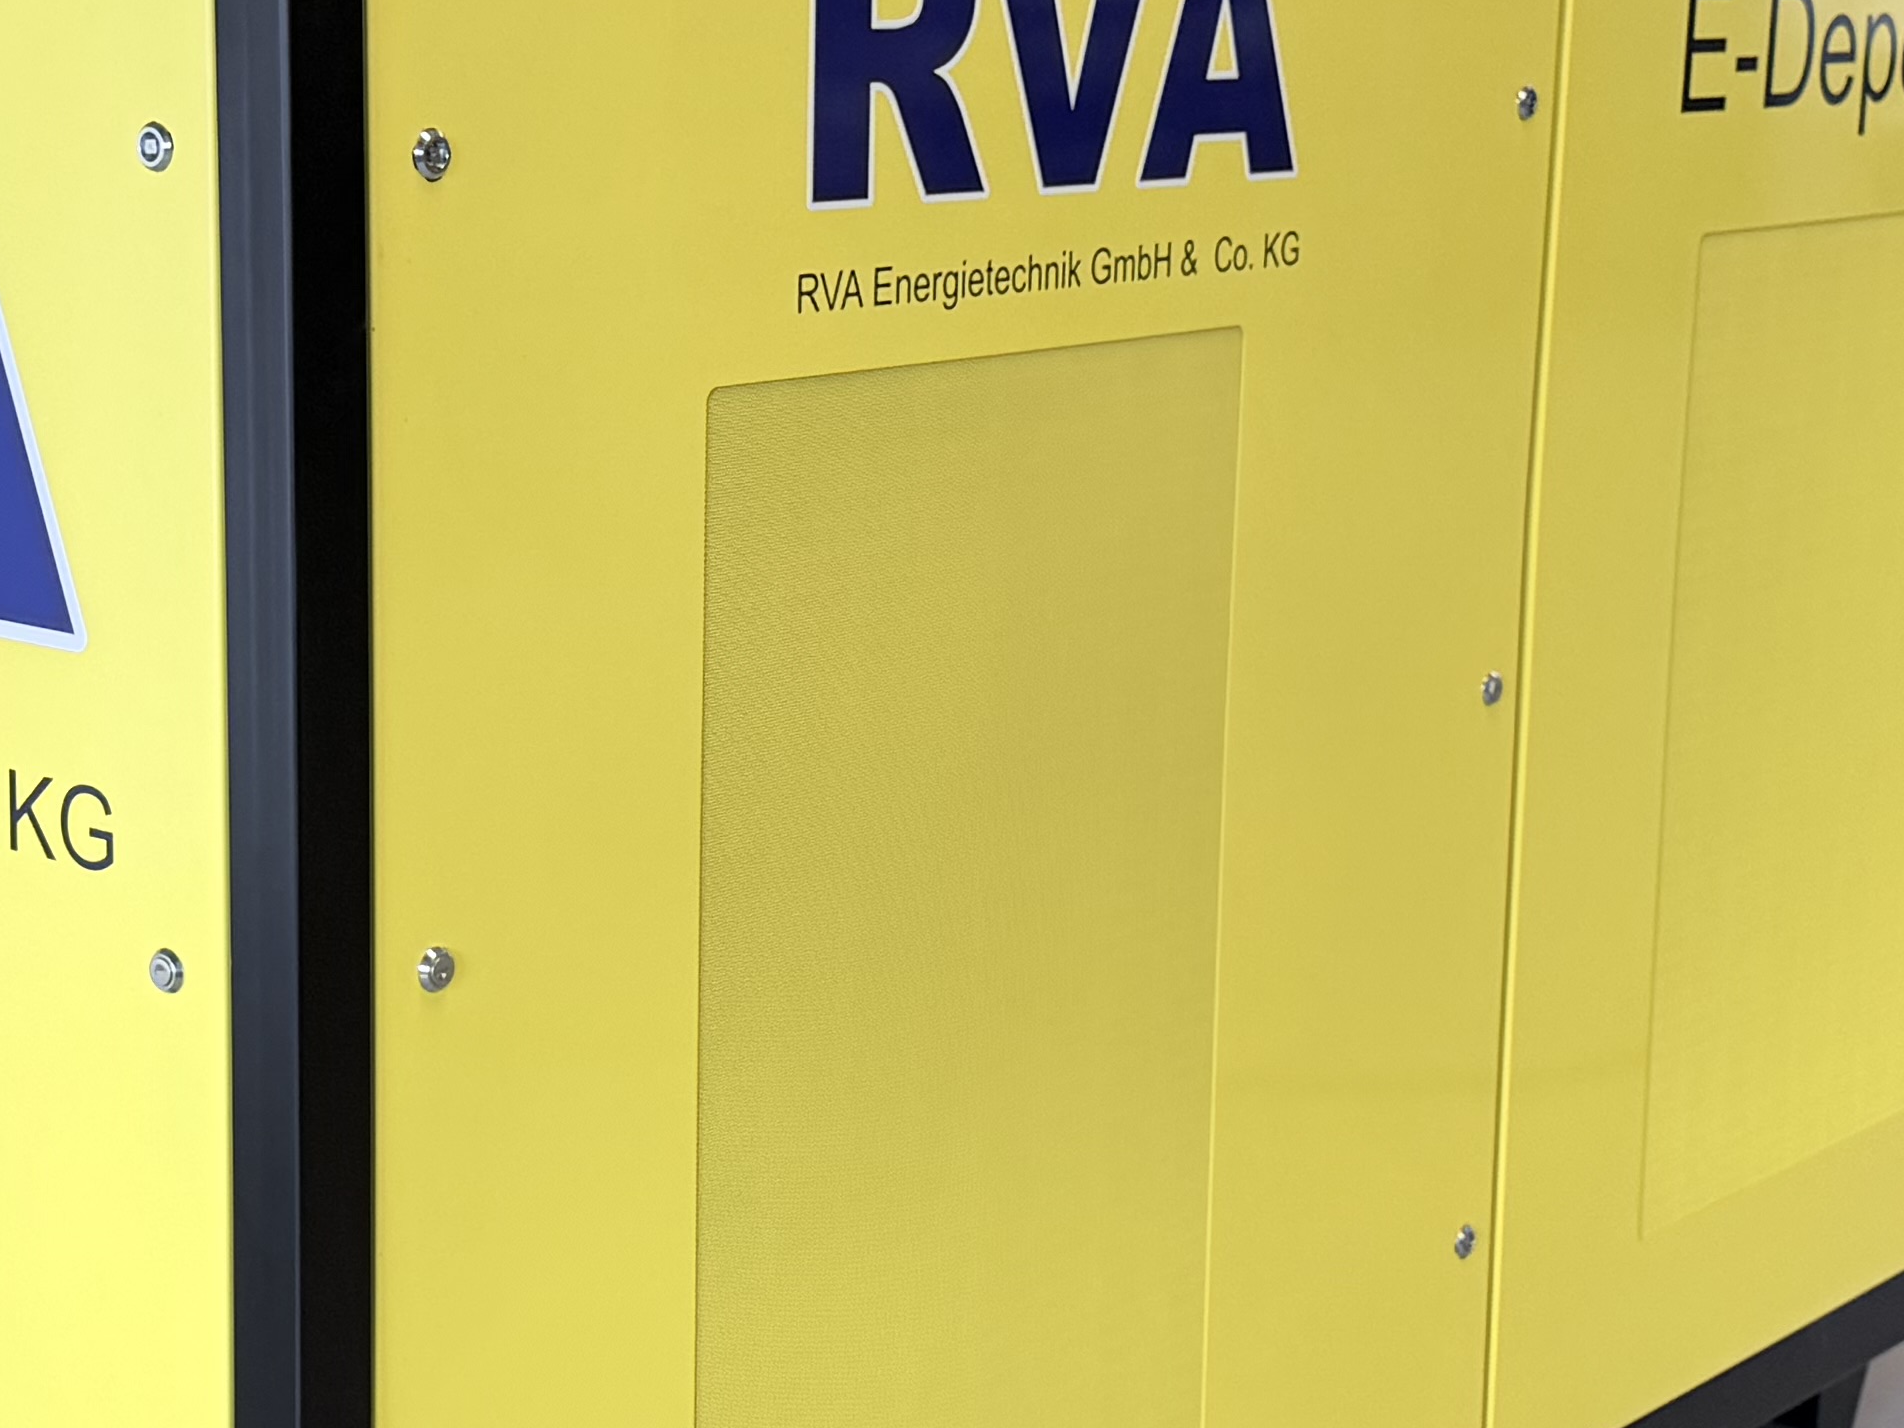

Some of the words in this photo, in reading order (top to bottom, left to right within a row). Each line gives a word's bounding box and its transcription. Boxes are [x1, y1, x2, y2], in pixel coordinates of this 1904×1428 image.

[797, 269, 864, 314] RVA
[873, 250, 1082, 311] Energietechnik
[1091, 241, 1172, 286] GmbH
[1180, 239, 1198, 276] &
[1214, 235, 1254, 273] Co.
[1263, 230, 1300, 269] KG
[8, 768, 115, 872] KG
